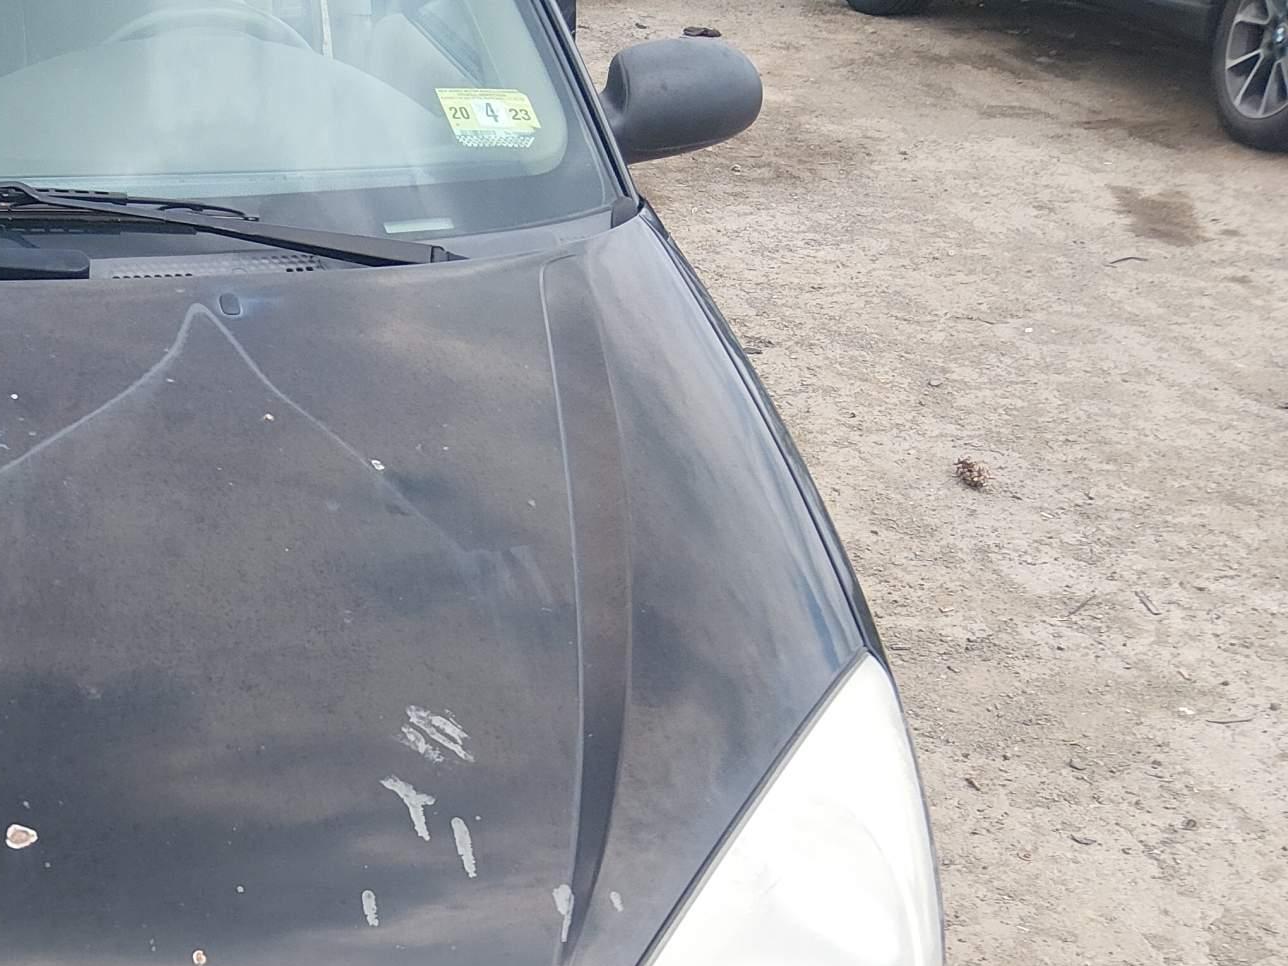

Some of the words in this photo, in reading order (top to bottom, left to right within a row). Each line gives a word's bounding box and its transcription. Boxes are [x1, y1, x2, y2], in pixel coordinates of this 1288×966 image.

[449, 106, 470, 120] 20
[486, 103, 498, 122] 4
[509, 108, 531, 121] 23
